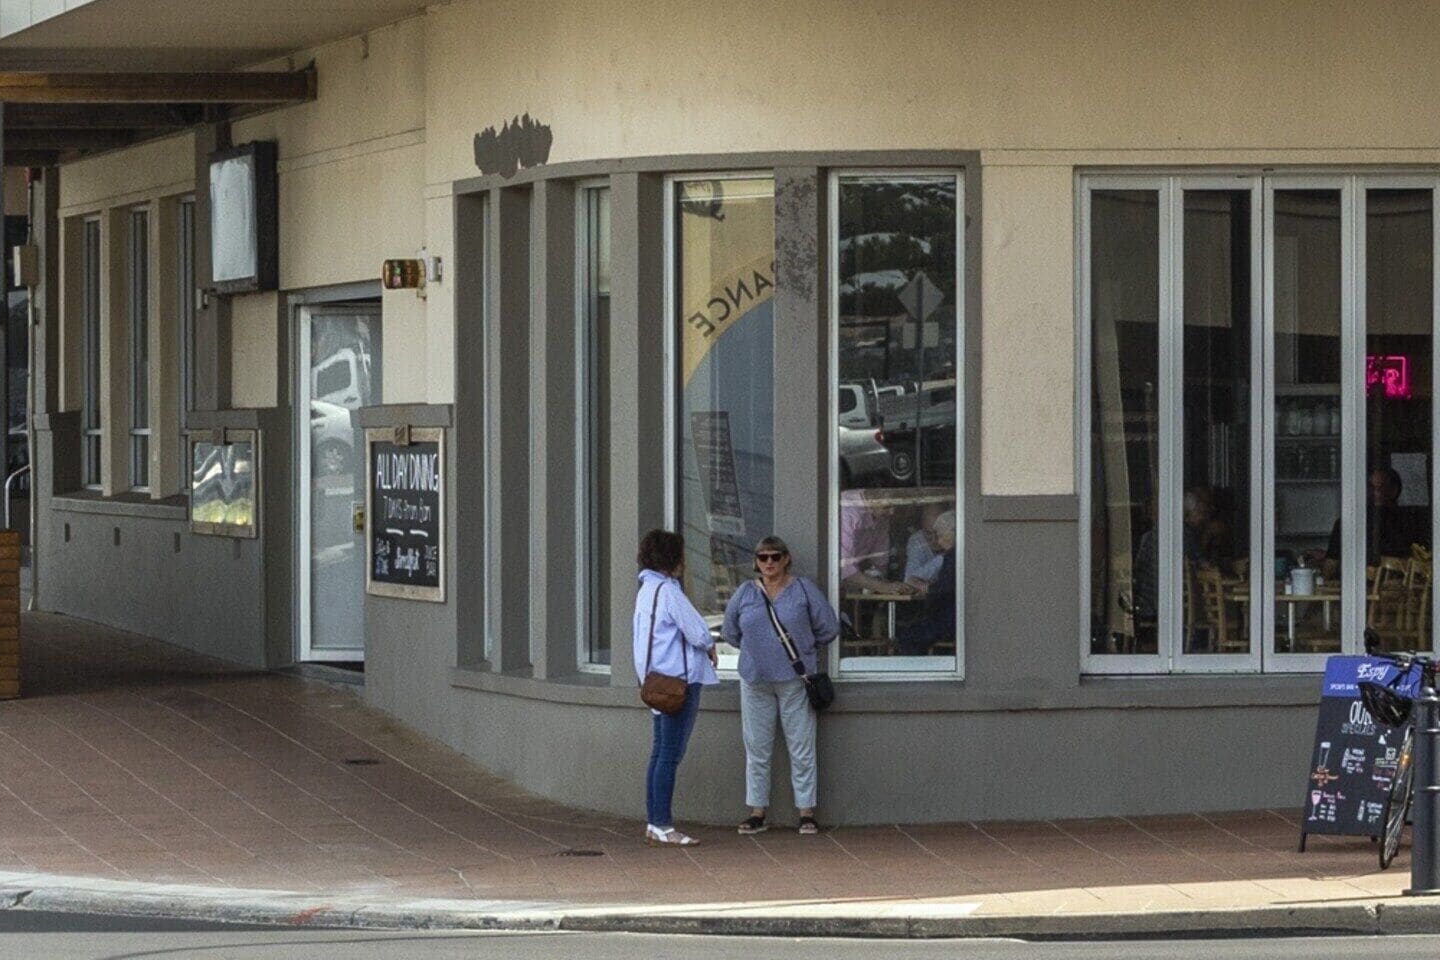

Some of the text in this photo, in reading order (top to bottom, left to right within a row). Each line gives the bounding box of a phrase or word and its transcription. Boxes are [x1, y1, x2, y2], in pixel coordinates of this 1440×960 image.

[376, 453, 439, 492] ALL DAY DINING
[1356, 663, 1390, 681] Espy
